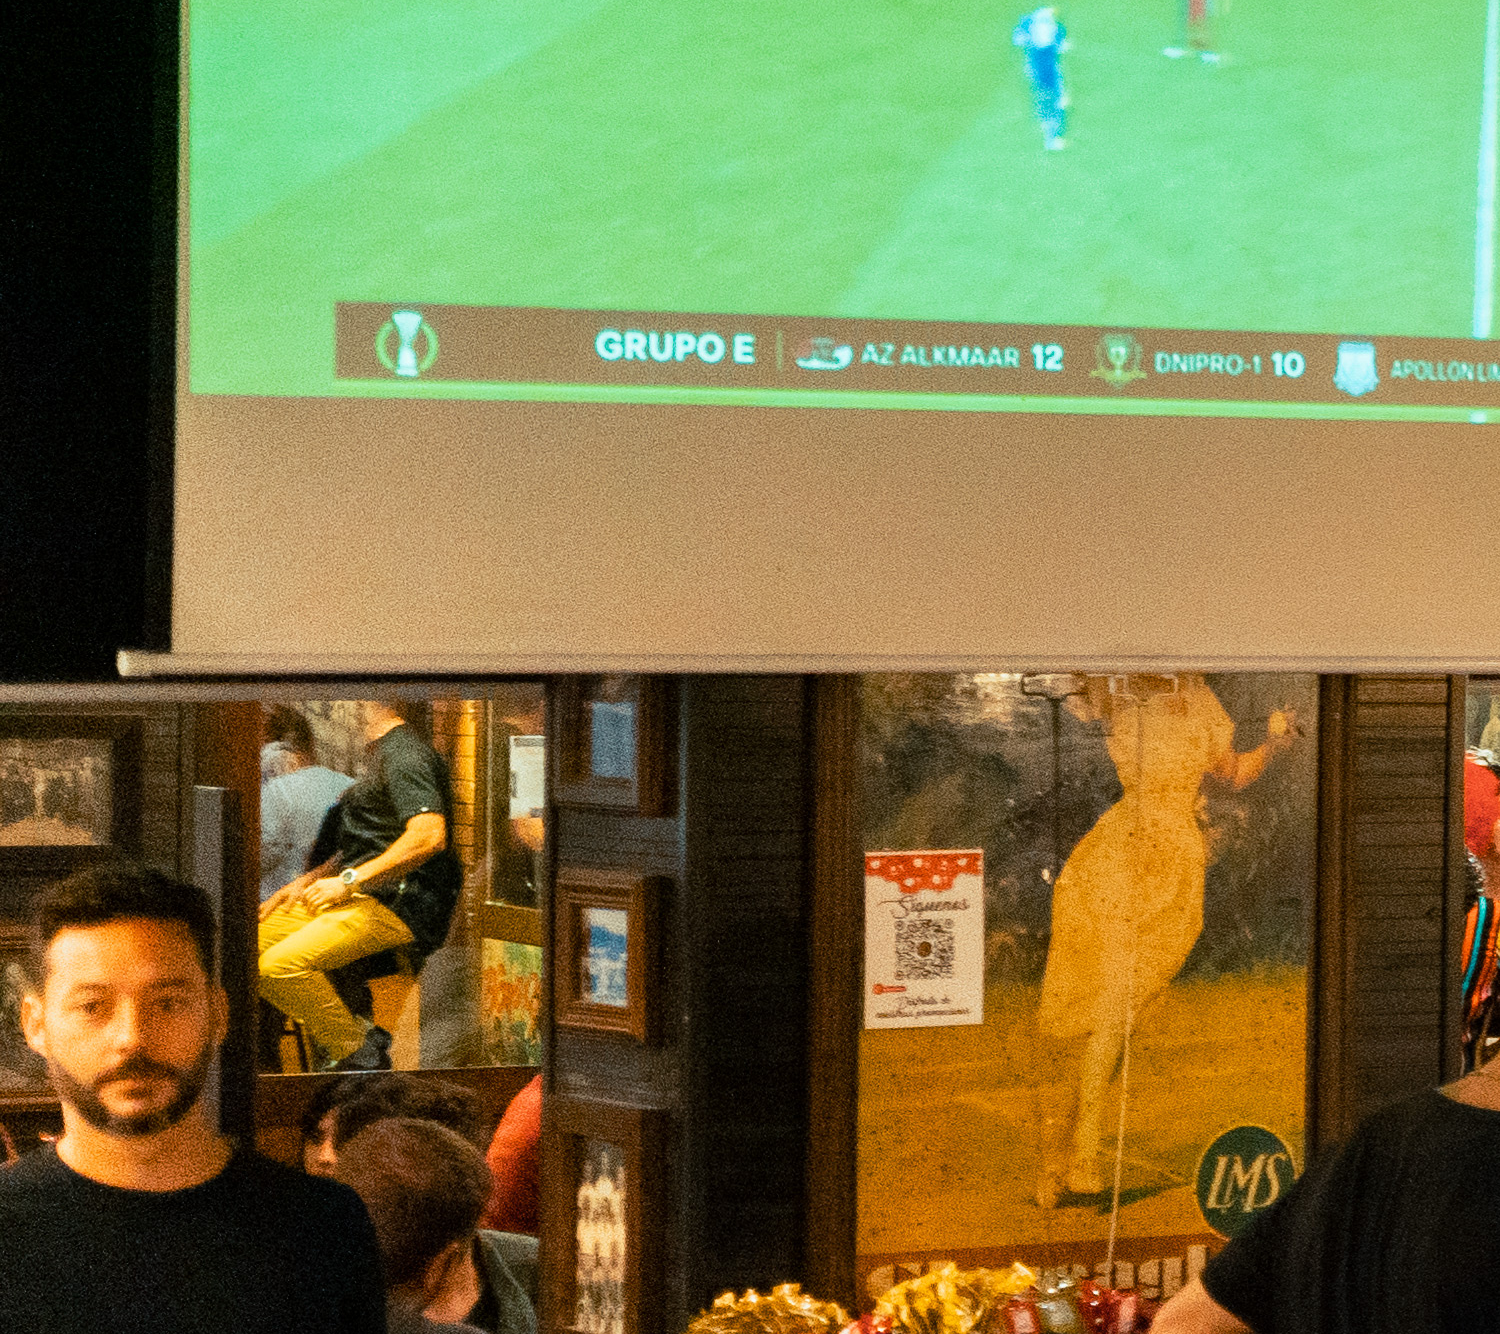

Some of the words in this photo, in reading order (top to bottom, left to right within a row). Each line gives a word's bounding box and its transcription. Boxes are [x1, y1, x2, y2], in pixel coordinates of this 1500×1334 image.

[594, 329, 725, 364] GRUPO
[733, 333, 755, 365] E
[861, 341, 894, 367] AZ
[899, 343, 1019, 369] ALKMAAR
[1030, 343, 1064, 372] 12
[1153, 350, 1263, 376] DNIPRO-1
[1270, 351, 1305, 378] 10
[1205, 1153, 1293, 1213] LMS
